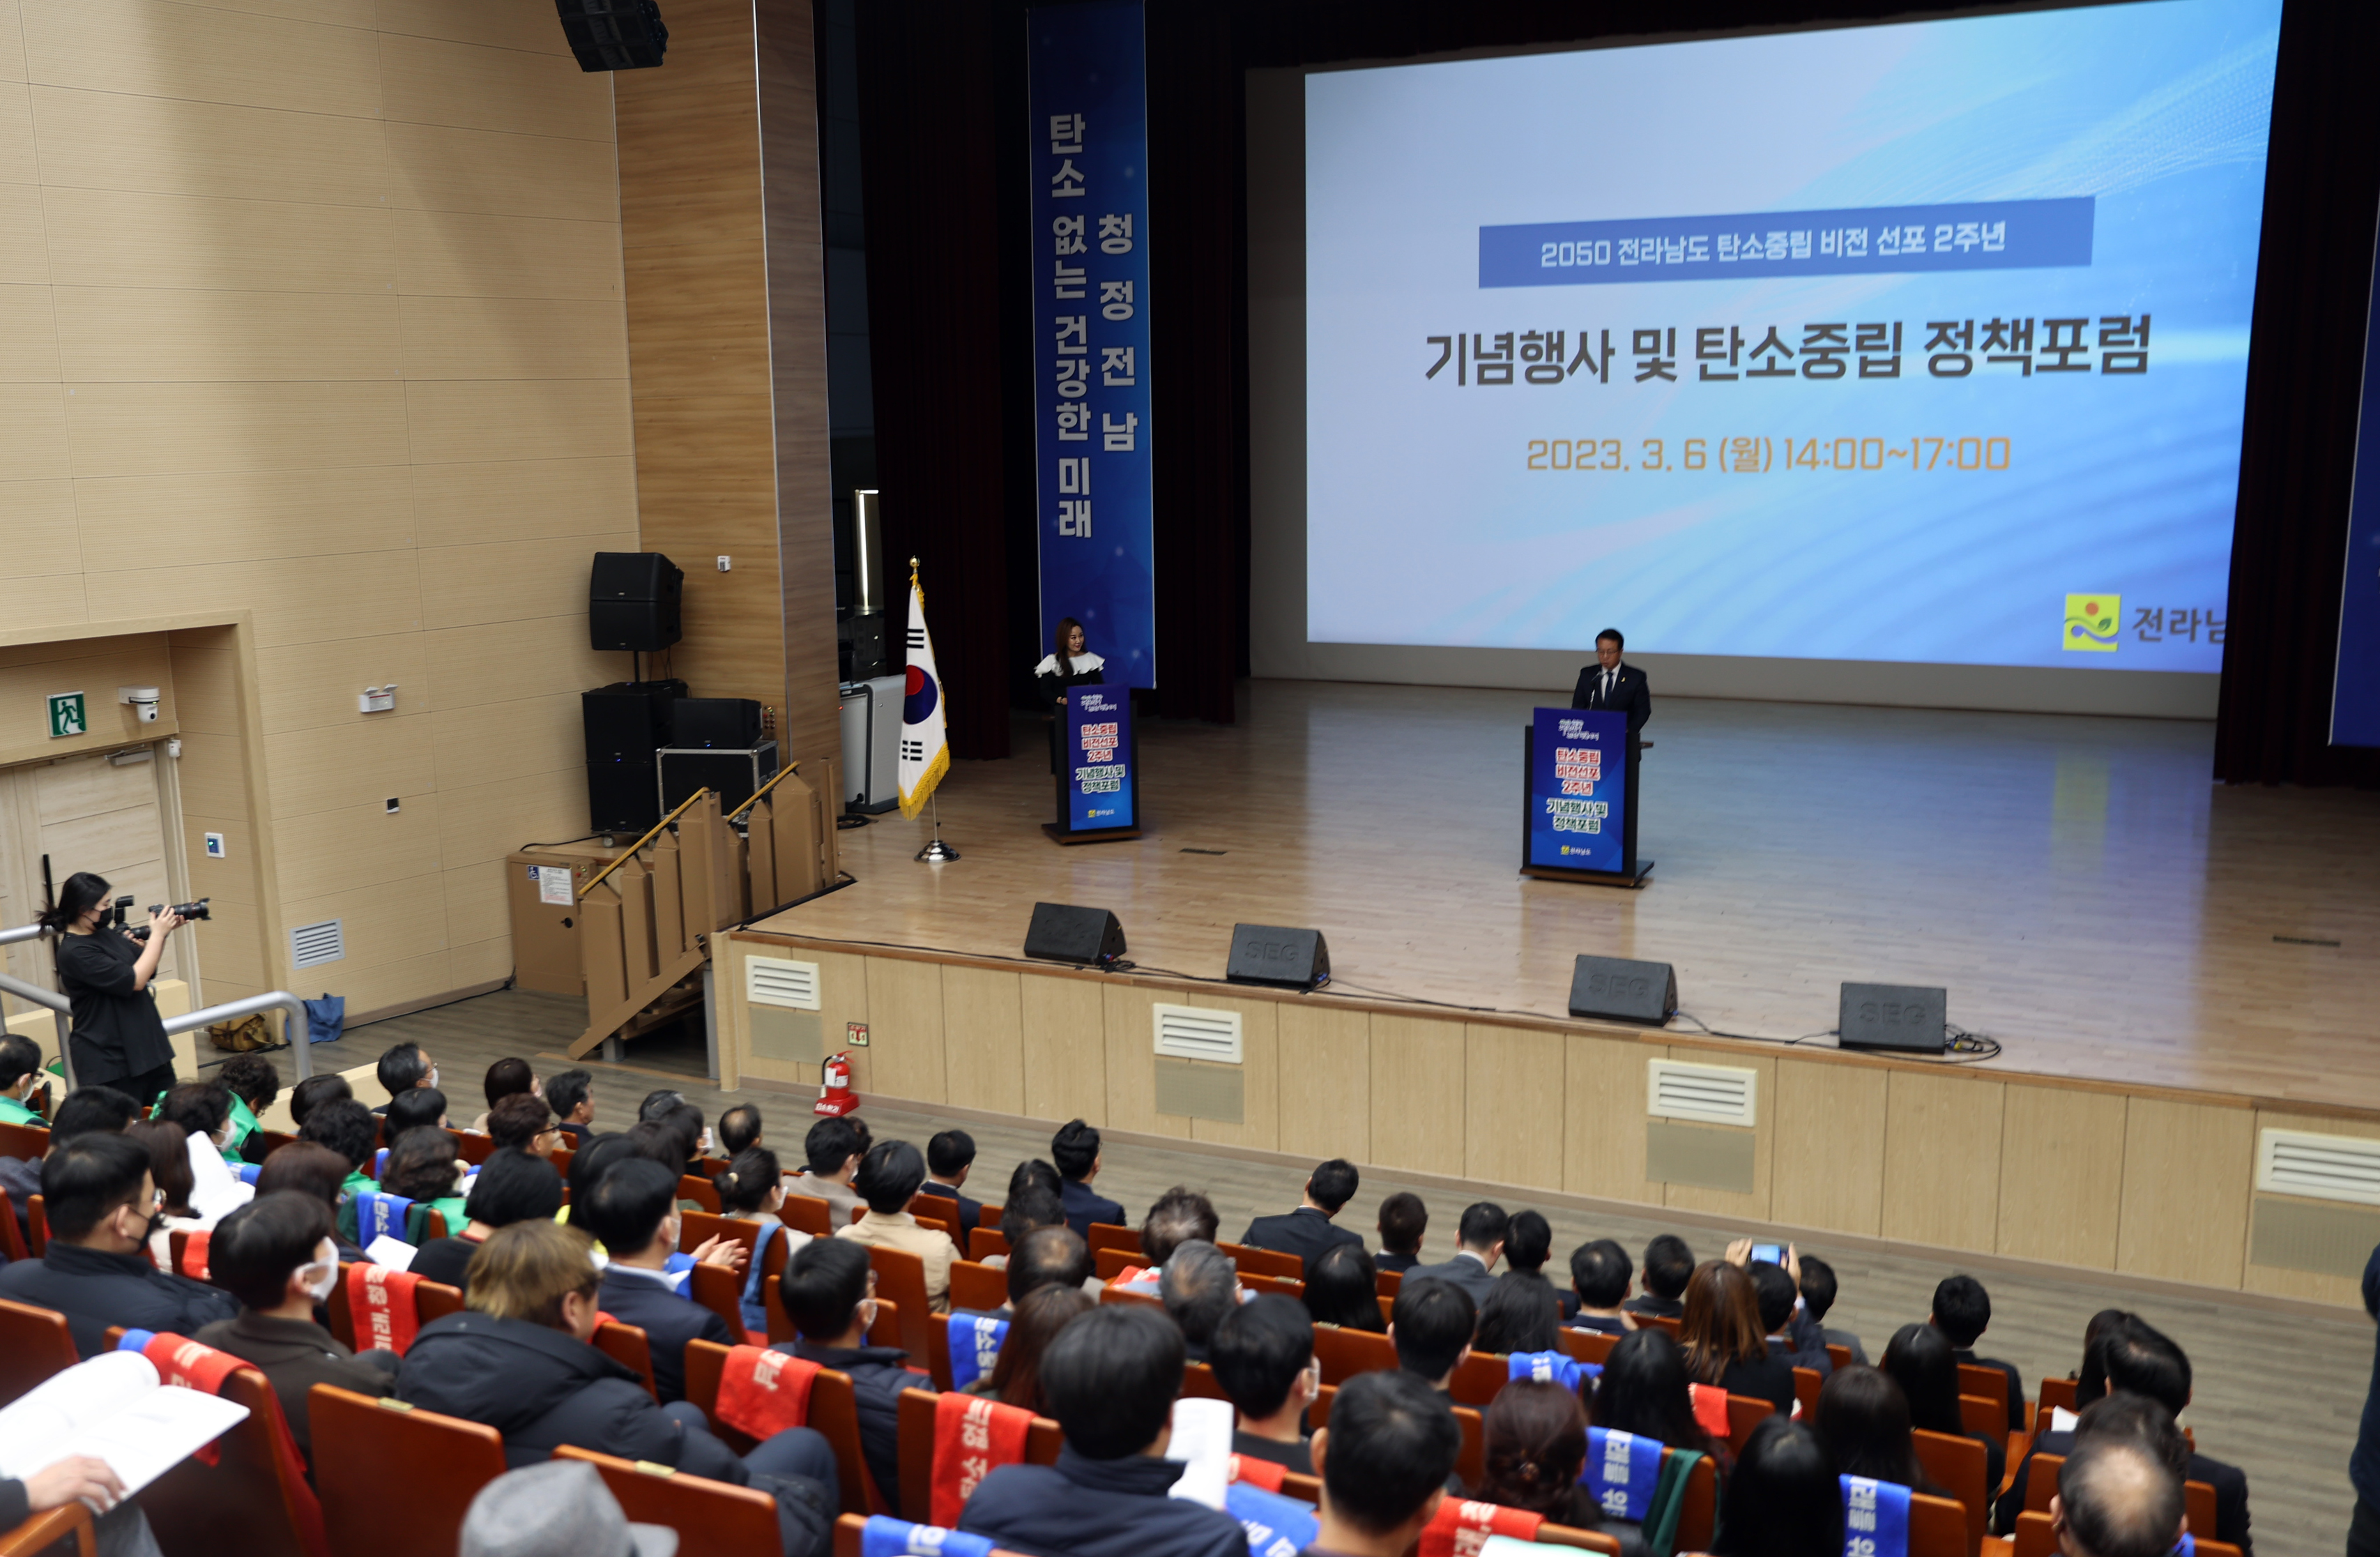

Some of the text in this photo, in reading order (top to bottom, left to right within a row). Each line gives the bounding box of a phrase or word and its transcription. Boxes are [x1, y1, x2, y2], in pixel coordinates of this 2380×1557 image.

[1541, 220, 2006, 267] 2050 전라남도 탄소중립 비전 선포 2주년
[1049, 114, 1092, 538] 탄소 없는 건강한 미래
[1425, 314, 2151, 386] 기념행사 및 탄소중립 정책포럼
[1527, 439, 1631, 472] 2023.
[1642, 439, 1673, 472] 3.
[1785, 437, 2011, 471] 14:00~17:00
[1081, 722, 1117, 737] 탄소중립
[1082, 736, 1118, 750] 비전선포
[1088, 750, 1113, 763] 2주년
[1556, 747, 1600, 765] 탄소중립
[1076, 764, 1125, 780] 기념행사 및
[1555, 764, 1600, 781] 비전선포
[1082, 780, 1120, 793] 정책포럼
[1562, 780, 1593, 796] 2주년
[1546, 798, 1608, 818] 기념행사 및
[1553, 816, 1600, 834] 정책포럼
[1245, 941, 1299, 961] SEG
[1589, 974, 1649, 996] SEG
[1860, 1002, 1926, 1024] SEG
[1603, 1428, 1633, 1485] 래를
[1847, 1475, 1879, 1532] 래를
